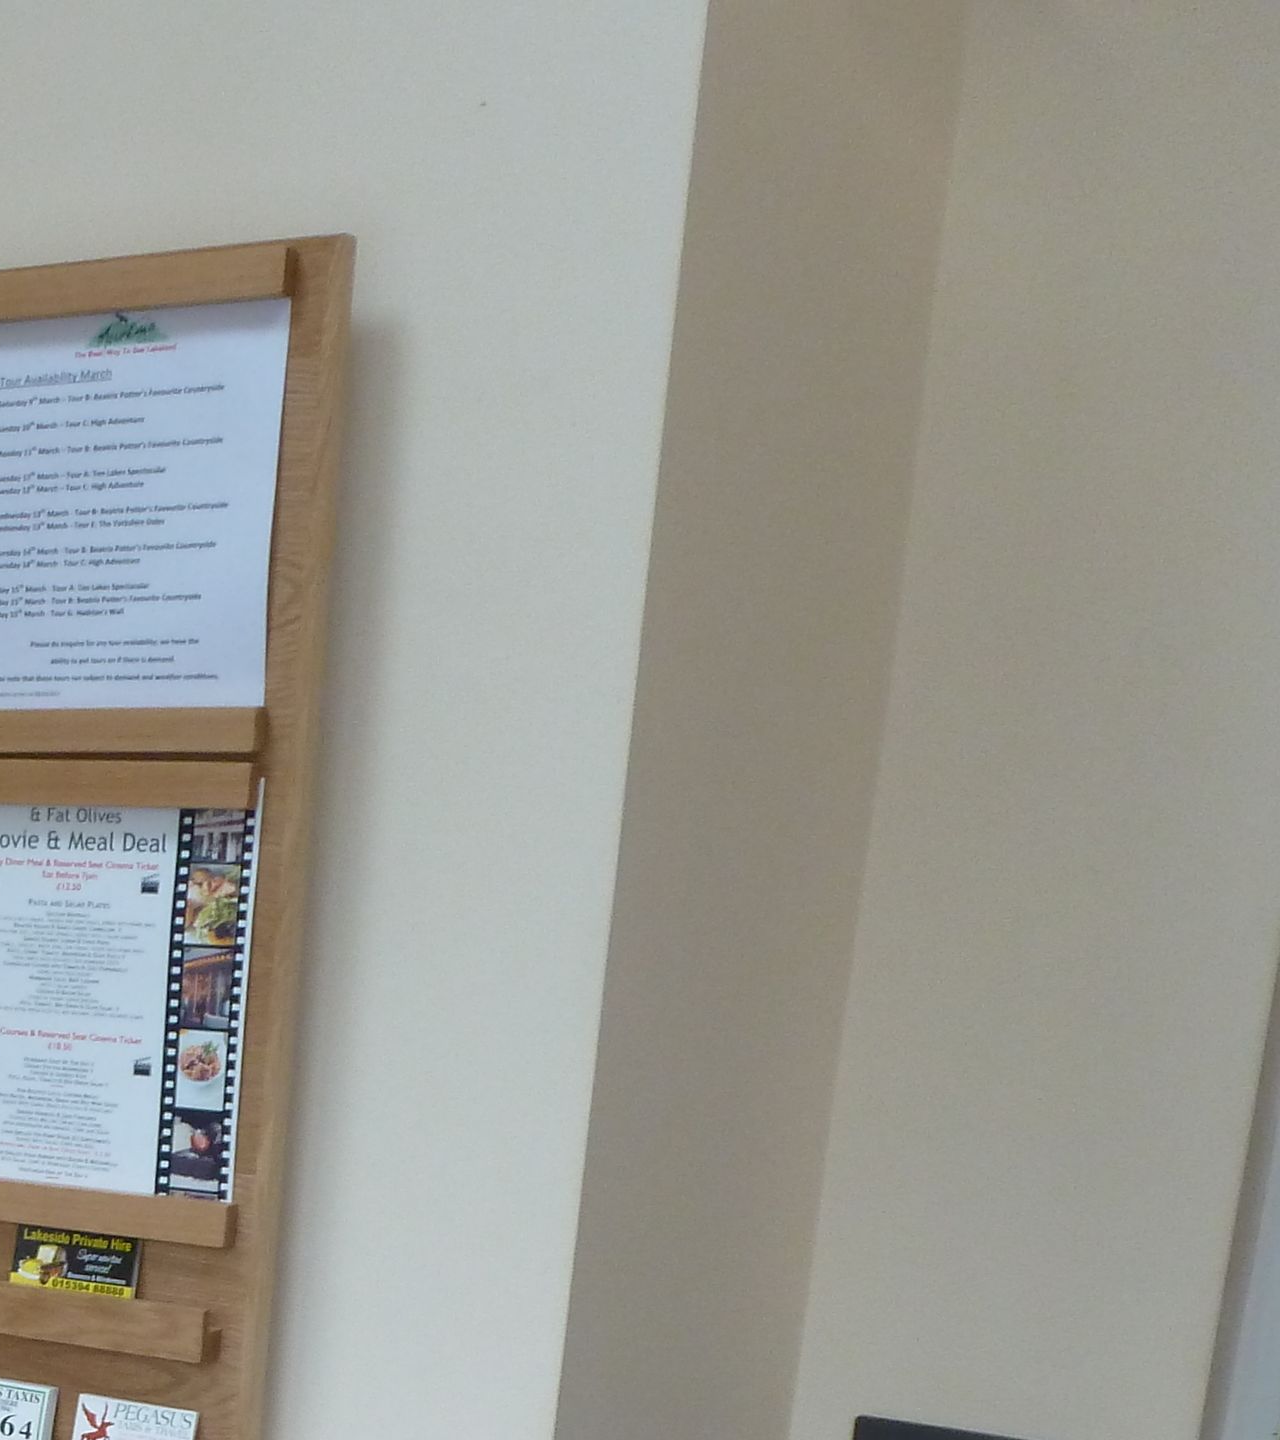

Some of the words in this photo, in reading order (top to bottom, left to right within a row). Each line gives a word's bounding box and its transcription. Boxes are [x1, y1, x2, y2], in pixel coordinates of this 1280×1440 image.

[0, 376, 22, 388] Tour
[24, 370, 78, 386] Availability
[80, 368, 112, 382] March
[39, 396, 60, 405] March
[67, 395, 84, 403] Tour
[184, 384, 225, 395] Countryside
[36, 421, 57, 430] March
[65, 420, 81, 428] Tour
[91, 418, 107, 428] High
[30, 808, 40, 823] &
[46, 808, 71, 823] Fat
[76, 808, 122, 824] Olives
[46, 830, 61, 850] &
[67, 831, 115, 852] Meal
[122, 832, 167, 853] Deal
[5, 857, 25, 866] Diner
[27, 858, 43, 867] Meal
[53, 858, 87, 869] Reserved
[105, 860, 134, 869] Cinema
[56, 870, 80, 880] Before
[82, 871, 98, 881] 7pm
[56, 882, 82, 891] £12.50
[0, 1026, 28, 1037] Courses
[38, 1029, 71, 1040] Reserved
[89, 1033, 118, 1043] Cinema
[23, 1227, 71, 1245] Lakeside
[72, 1234, 109, 1249] Private
[110, 1238, 133, 1252] Hire
[51, 1278, 91, 1292] 015394
[5, 1388, 42, 1404] TAXIS
[113, 1403, 193, 1429] PEGASUS
